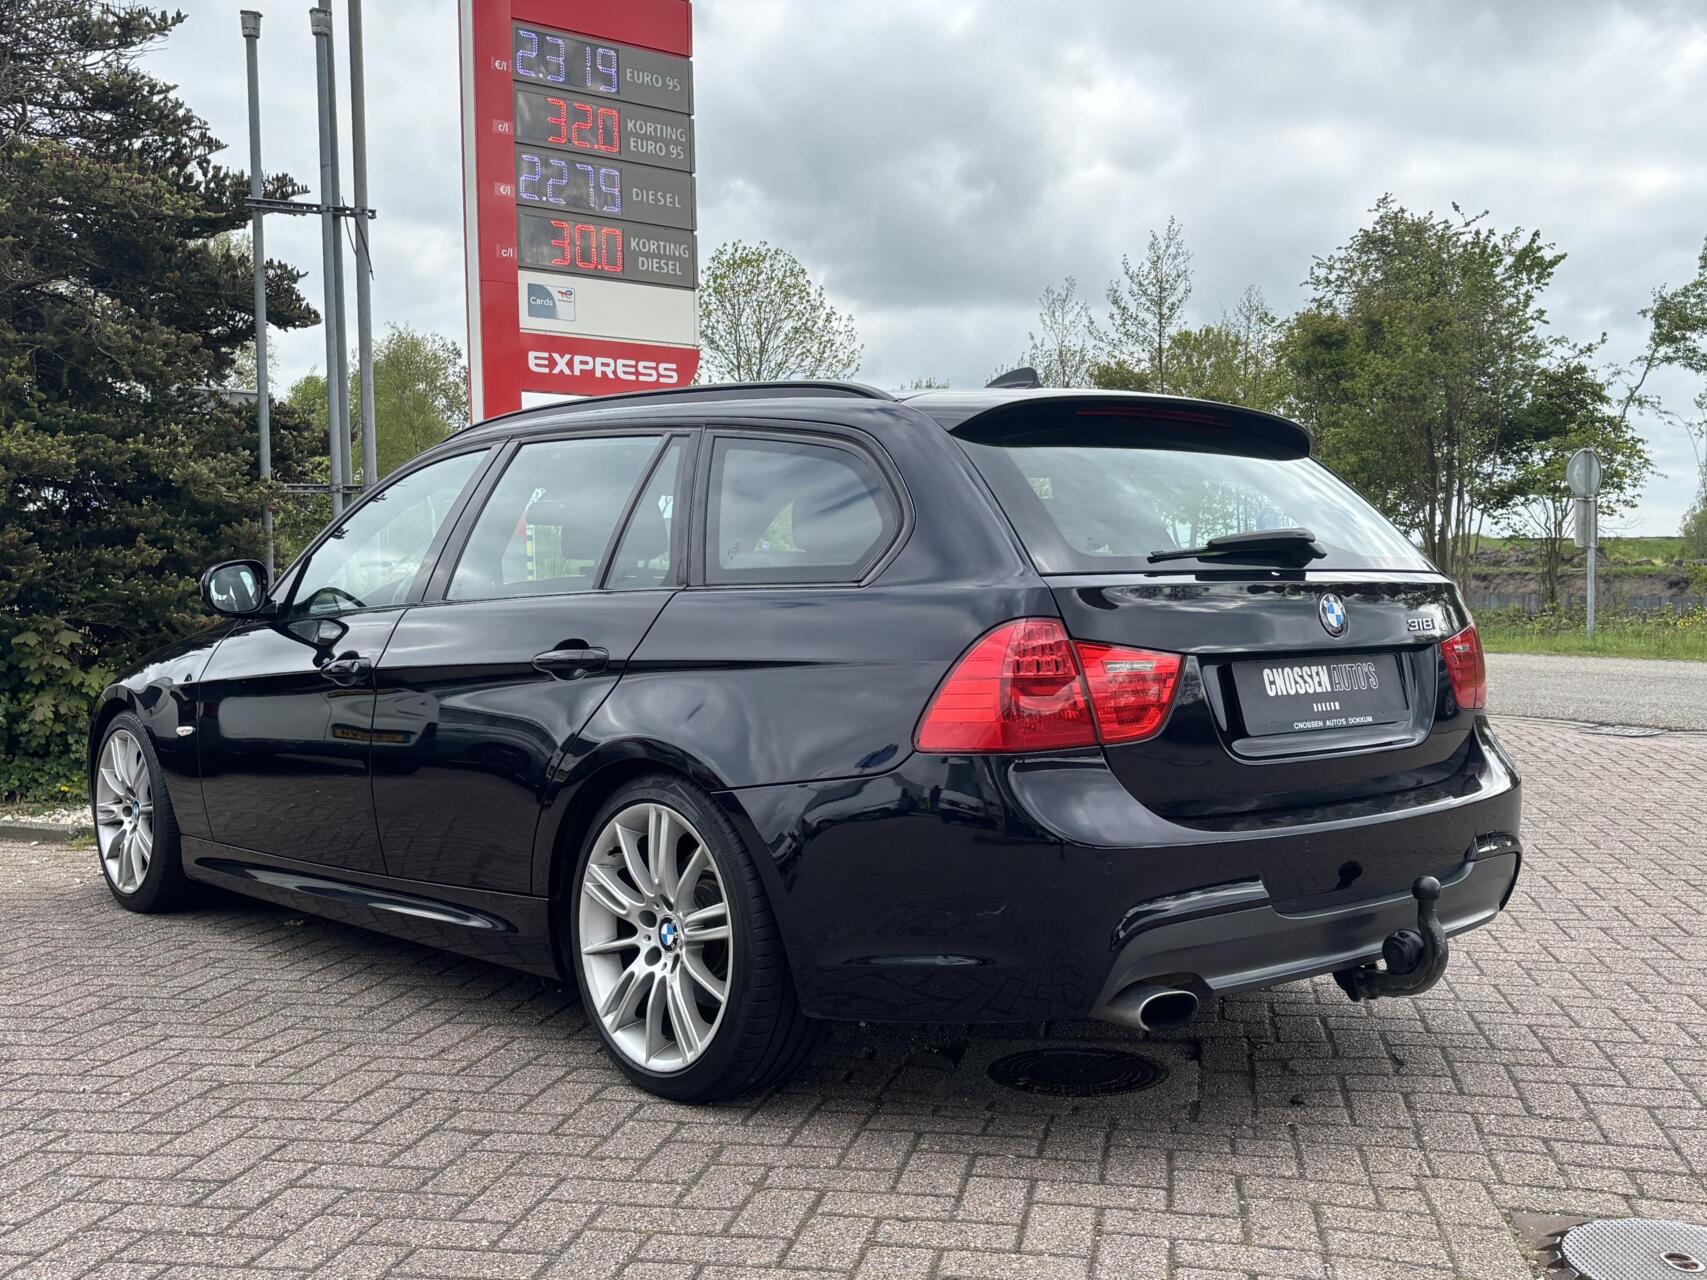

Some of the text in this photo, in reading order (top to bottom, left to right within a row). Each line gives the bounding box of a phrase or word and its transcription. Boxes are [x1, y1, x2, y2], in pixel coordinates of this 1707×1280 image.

[516, 29, 618, 93] 2.319
[626, 68, 681, 92] EURO 95
[547, 97, 620, 153] 32.0
[627, 118, 686, 142] KORTING
[630, 138, 684, 160] EURO 95
[520, 154, 621, 212] 2.279
[632, 188, 681, 208] DIESEL
[551, 220, 623, 272] 30.0
[630, 237, 689, 258] KORTING
[638, 256, 683, 275] DIESEL
[530, 296, 553, 306] Cards
[528, 351, 678, 384] EXPRESS
[1263, 662, 1379, 697] CNOSSEN AUTO'S
[1294, 715, 1373, 729] CNOSSEN AUTO'S DOKKUM
